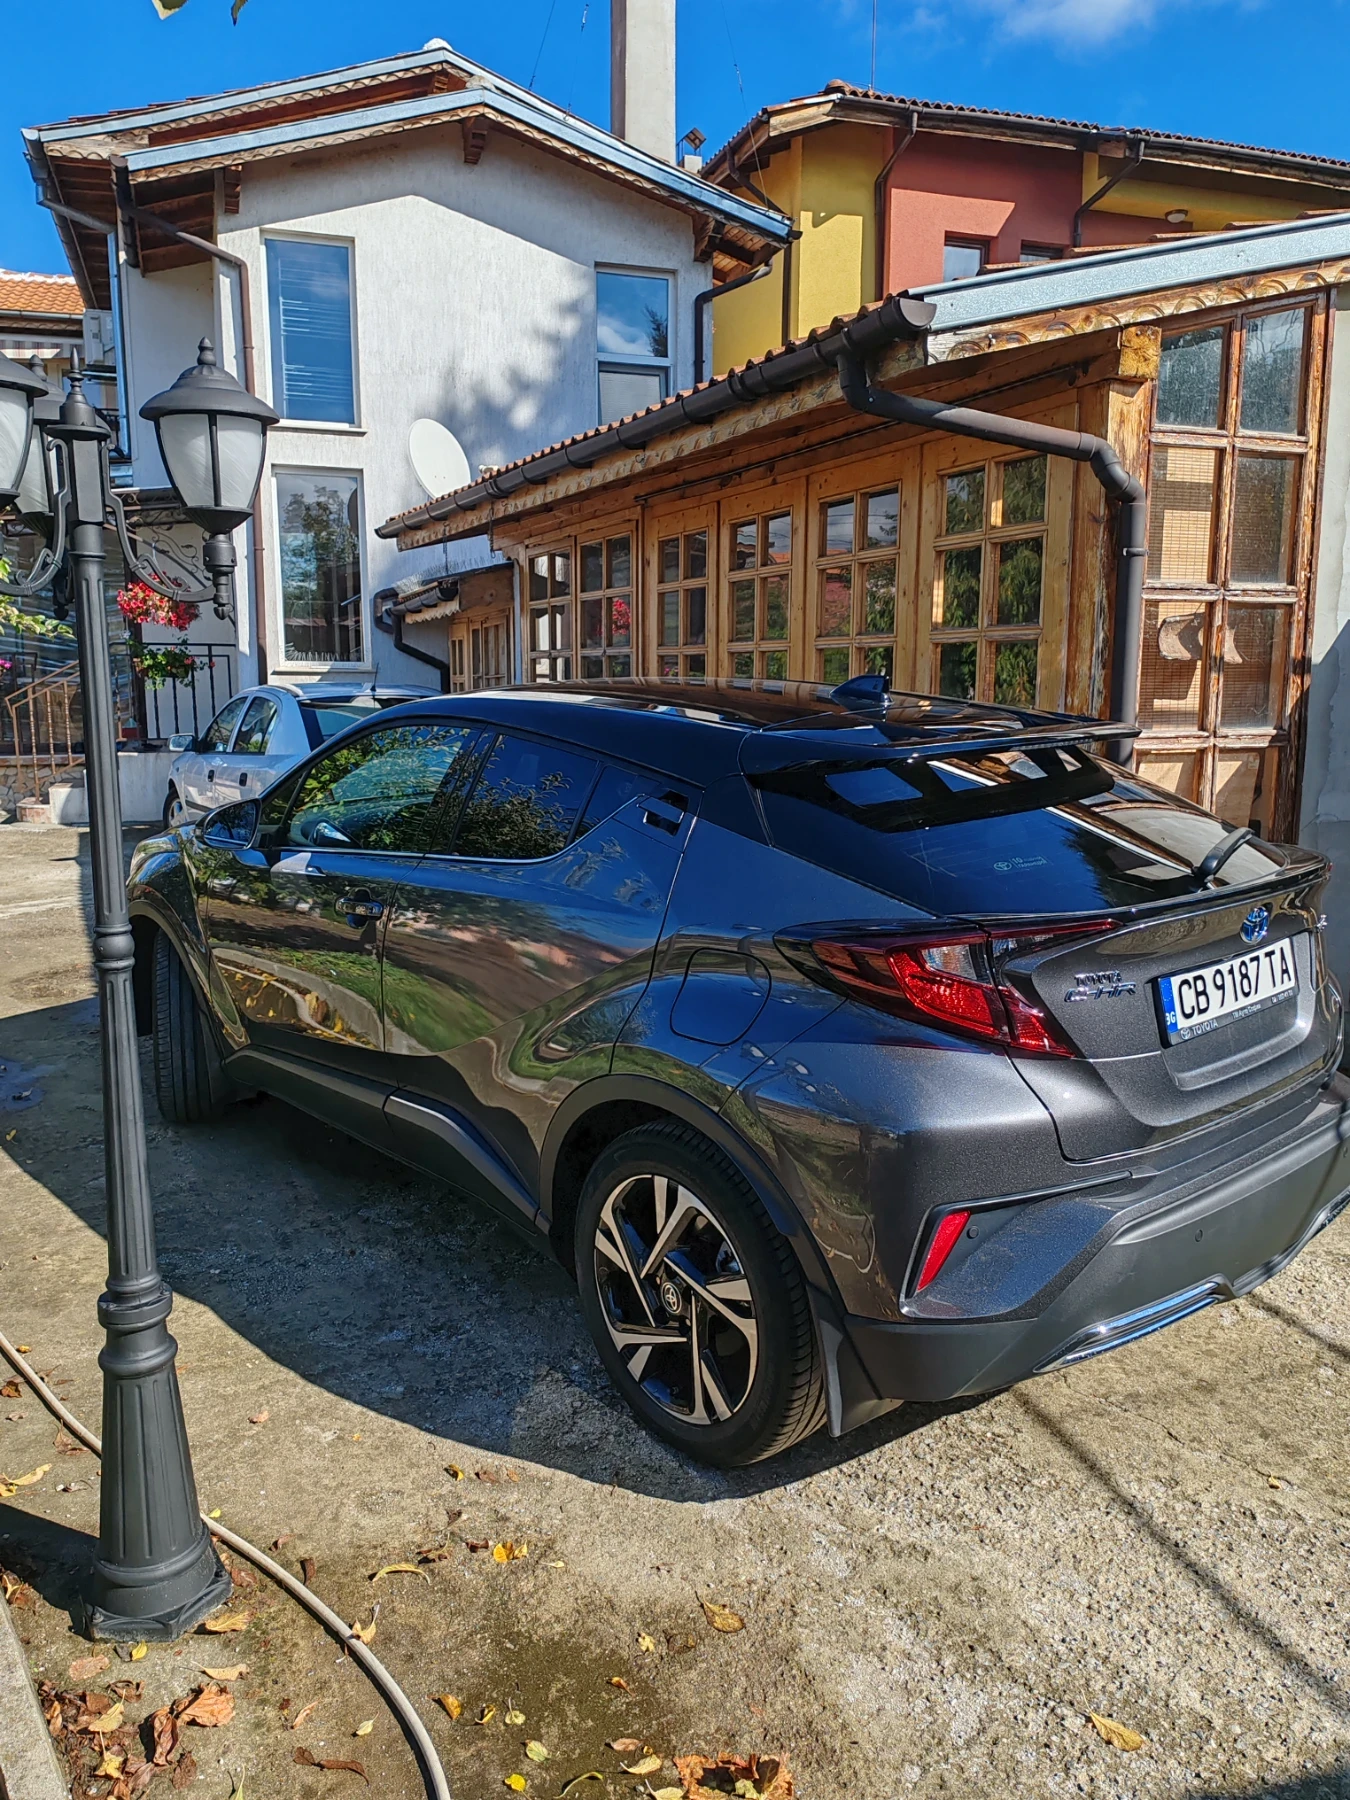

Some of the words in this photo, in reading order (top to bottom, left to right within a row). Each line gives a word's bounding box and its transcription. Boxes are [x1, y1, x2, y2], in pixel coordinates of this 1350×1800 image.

[1074, 969, 1122, 987] TOYOTA
[1178, 974, 1210, 1020] CB
[1213, 954, 1260, 1009] 9187
[1264, 946, 1292, 989] TA
[1064, 982, 1137, 1003] C-HR
[1192, 1019, 1219, 1036] TOYOTA
